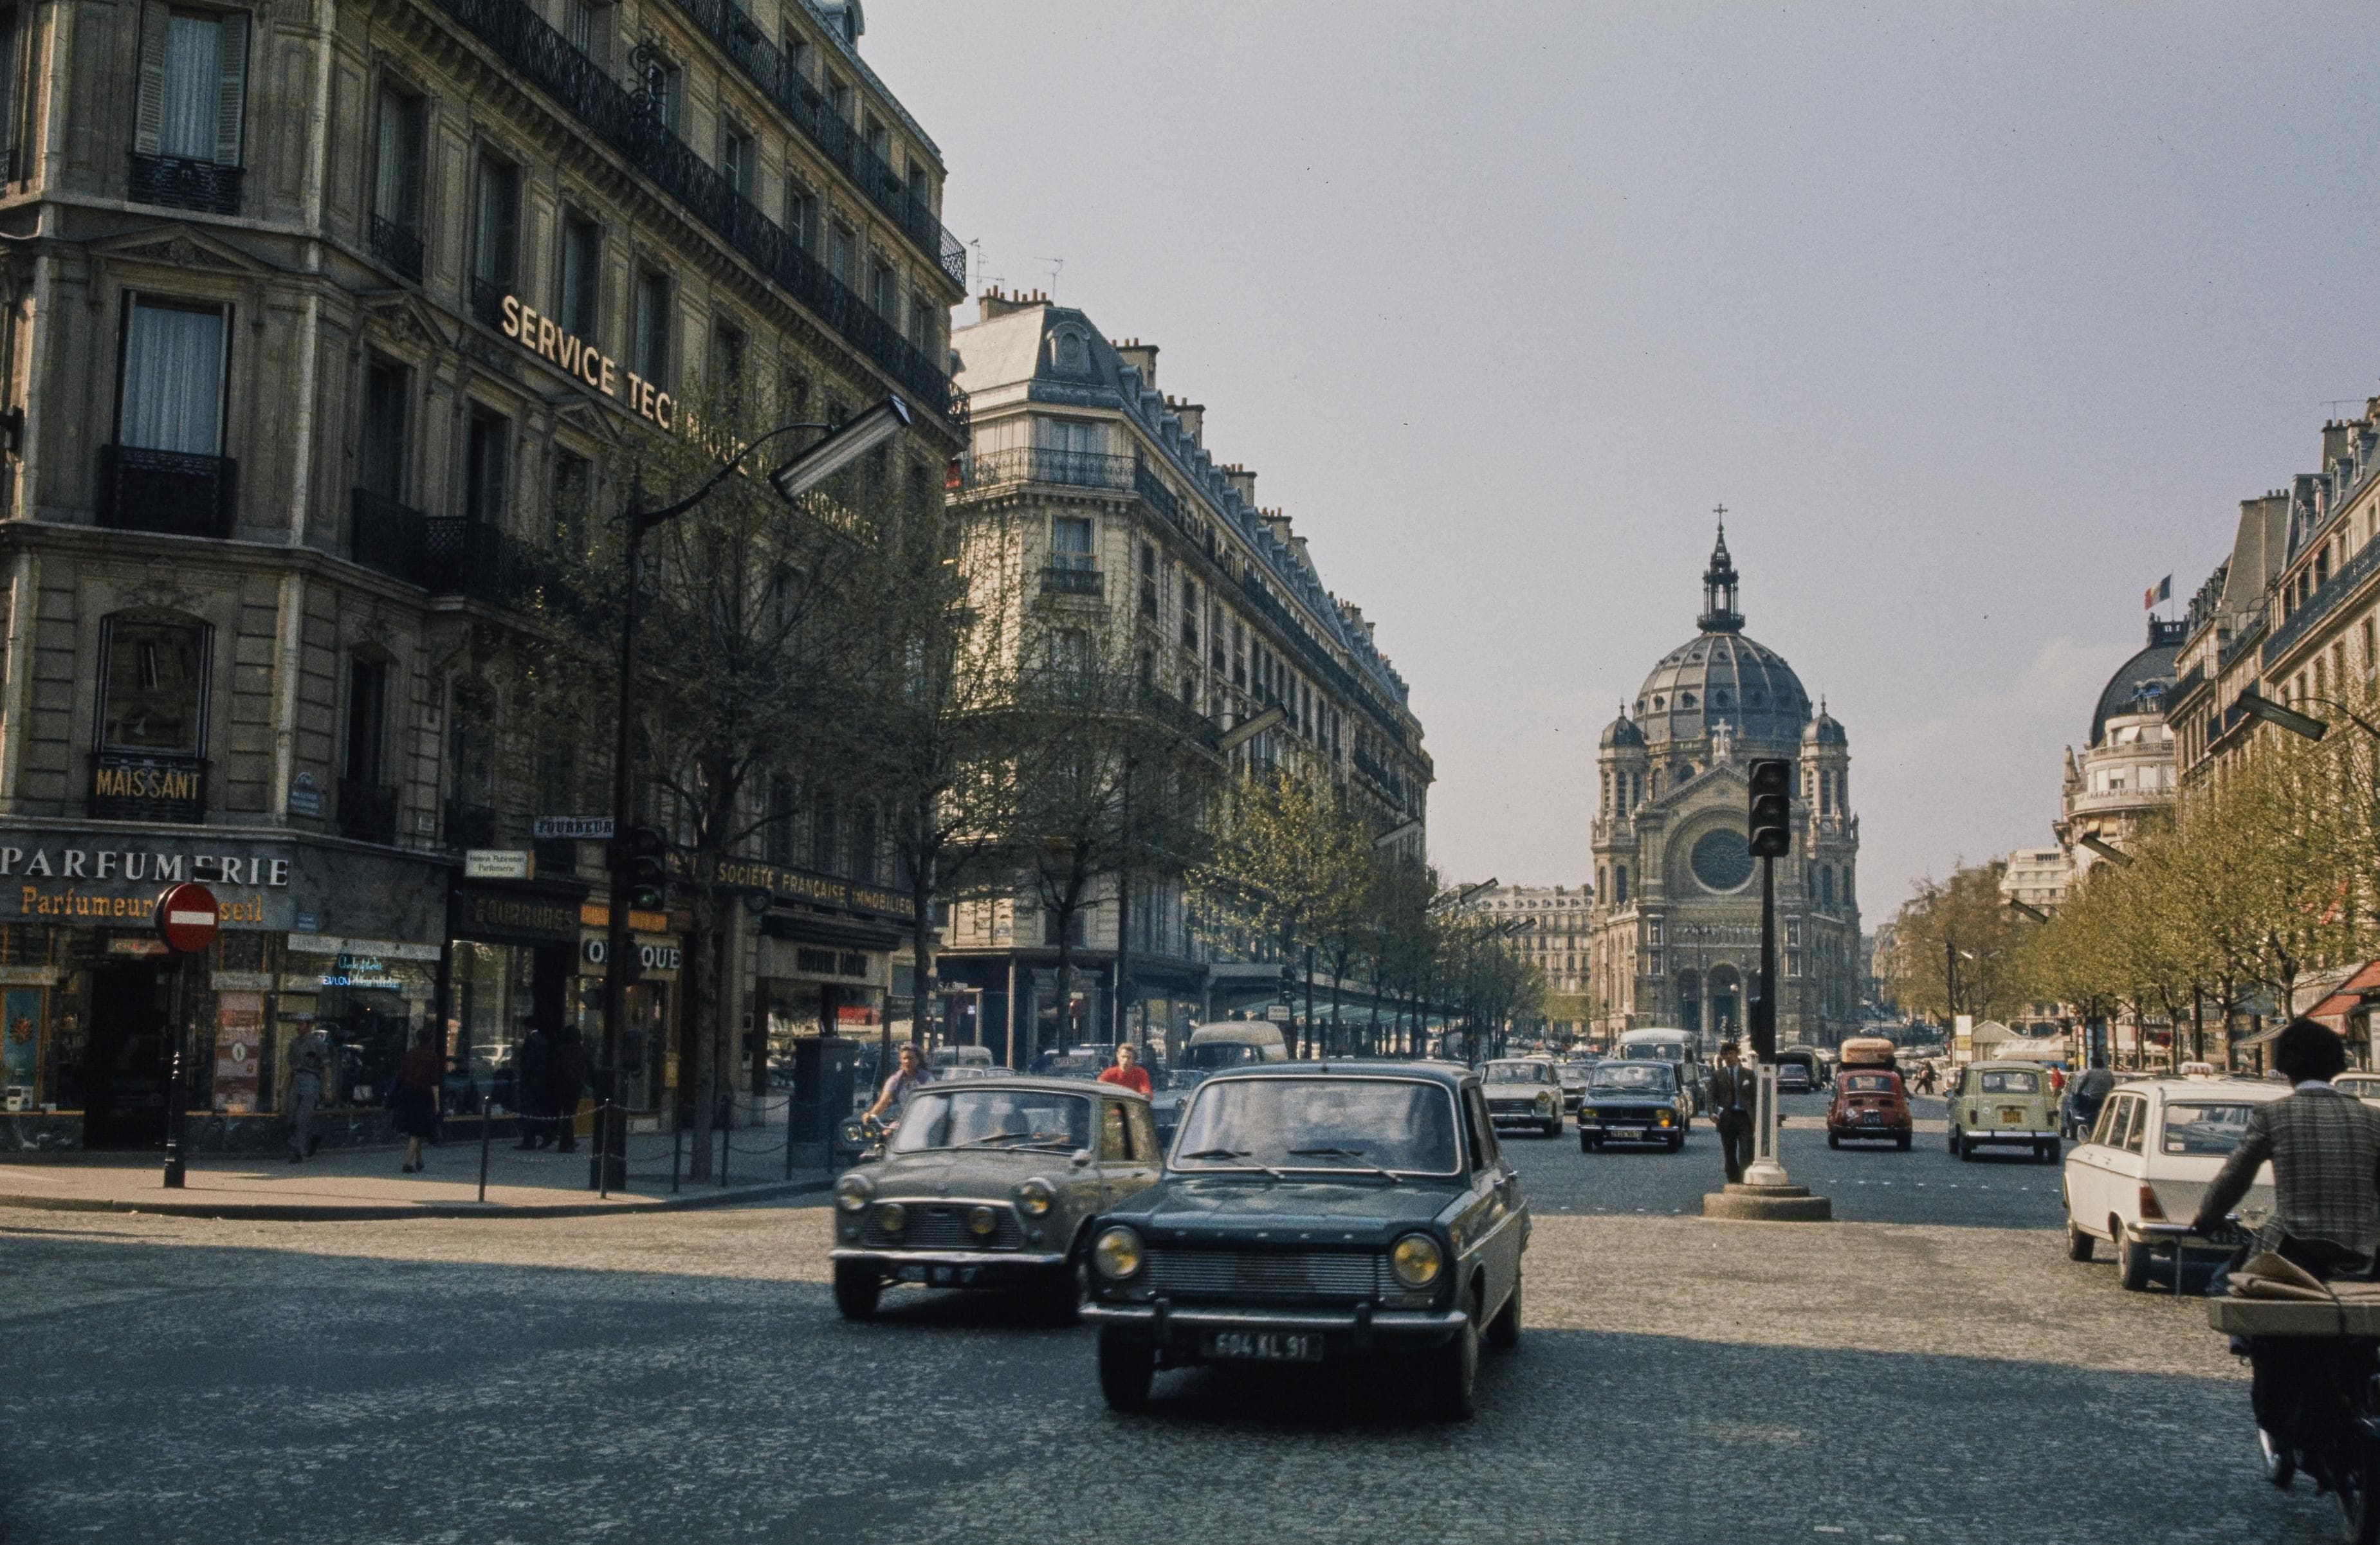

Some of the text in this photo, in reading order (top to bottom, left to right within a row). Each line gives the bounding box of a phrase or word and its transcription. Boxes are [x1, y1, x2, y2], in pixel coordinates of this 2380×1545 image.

[501, 295, 615, 396] SERVICE
[96, 769, 201, 800] MAISSANT
[0, 847, 289, 886] PARFUMERIE
[21, 886, 264, 922] Parfumeur seil
[589, 940, 682, 971] OQUE
